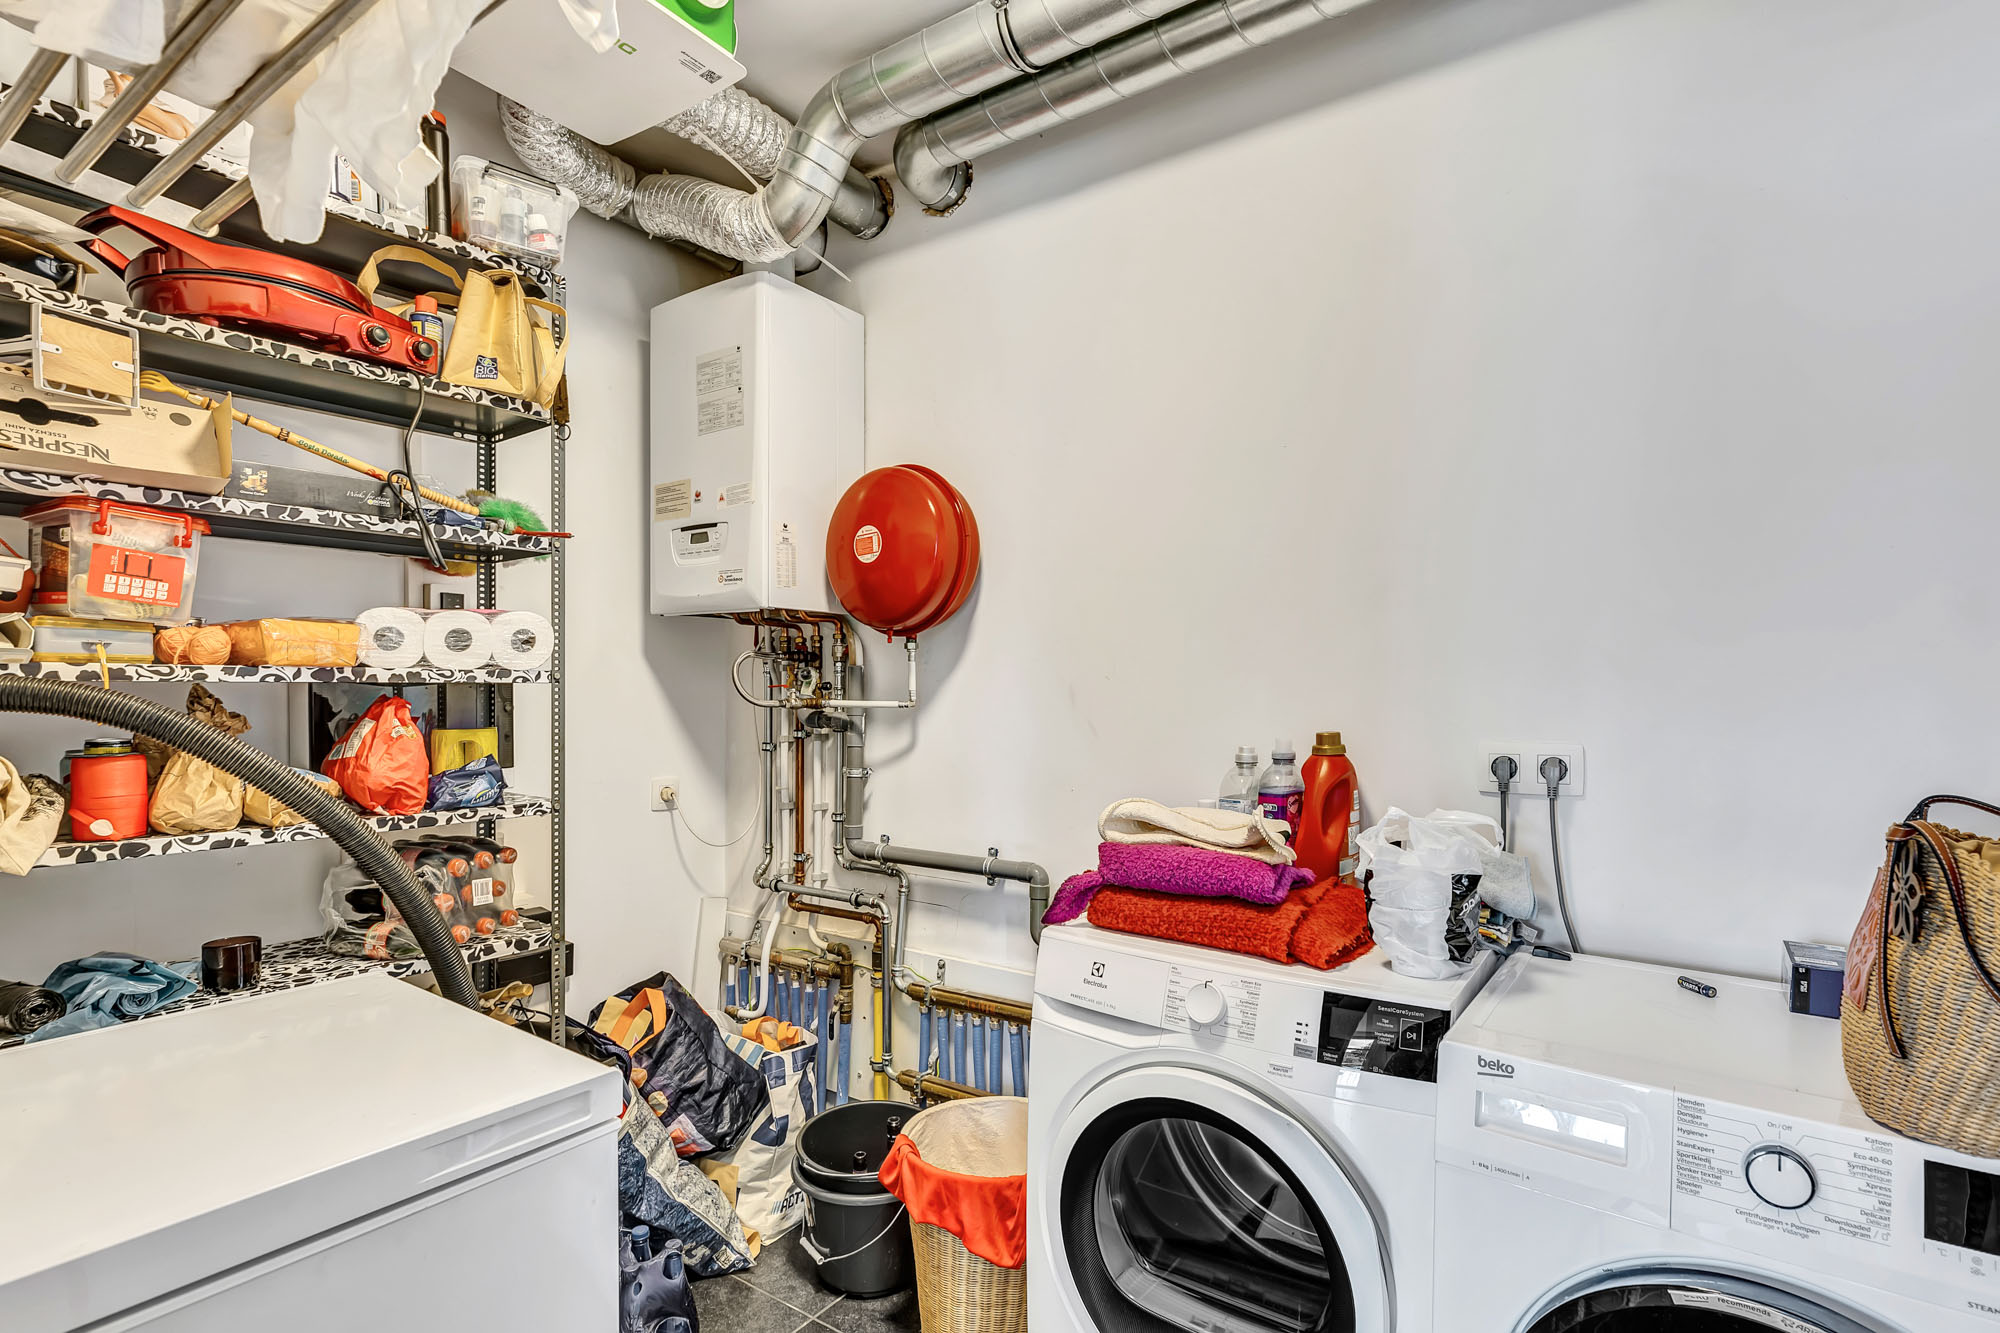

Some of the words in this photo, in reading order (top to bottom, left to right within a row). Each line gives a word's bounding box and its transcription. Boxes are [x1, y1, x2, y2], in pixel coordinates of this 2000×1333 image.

[4, 422, 29, 433] MINI
[30, 427, 67, 439] ESSENZA
[1083, 978, 1108, 989] Electrolux
[1682, 980, 1700, 993] VARTA
[1377, 1005, 1425, 1018] SensiCareSystem
[1478, 1055, 1515, 1074] beko
[1677, 1097, 1705, 1108] Hemden
[1677, 1103, 1706, 1114] Chemises
[1677, 1110, 1702, 1120] Donsjas
[1677, 1116, 1708, 1128] Doudoune
[1767, 1121, 1777, 1129] On
[1782, 1124, 1792, 1132] Off
[1677, 1127, 1708, 1138] Hygiene+
[1676, 1140, 1715, 1154] StainExpert
[1864, 1136, 1893, 1148] Katoen
[1871, 1144, 1893, 1154] Coton
[1676, 1150, 1712, 1164] Sportkledij
[1853, 1152, 1867, 1162] Eco
[1868, 1156, 1893, 1166] 40-60
[1676, 1157, 1706, 1170] Vêtement
[1716, 1167, 1733, 1176] sport
[1676, 1164, 1700, 1175] Donker
[1700, 1170, 1722, 1180] textiel
[1847, 1161, 1892, 1177] Synthetisch
[1676, 1170, 1700, 1180] Textiles
[1676, 1178, 1702, 1190] Spoelen
[1866, 1181, 1892, 1193] Xpress
[1878, 1200, 1892, 1208] Wol
[1860, 1209, 1891, 1222] Delicaat
[1735, 1208, 1782, 1226] Centrifugeren
[1790, 1223, 1820, 1236] Pompen
[1745, 1217, 1774, 1232] Essorage
[1782, 1227, 1810, 1239] Vidange
[1824, 1216, 1872, 1233] Downloaded
[1838, 1226, 1872, 1240] Program
[1717, 1297, 1772, 1318] recommends
